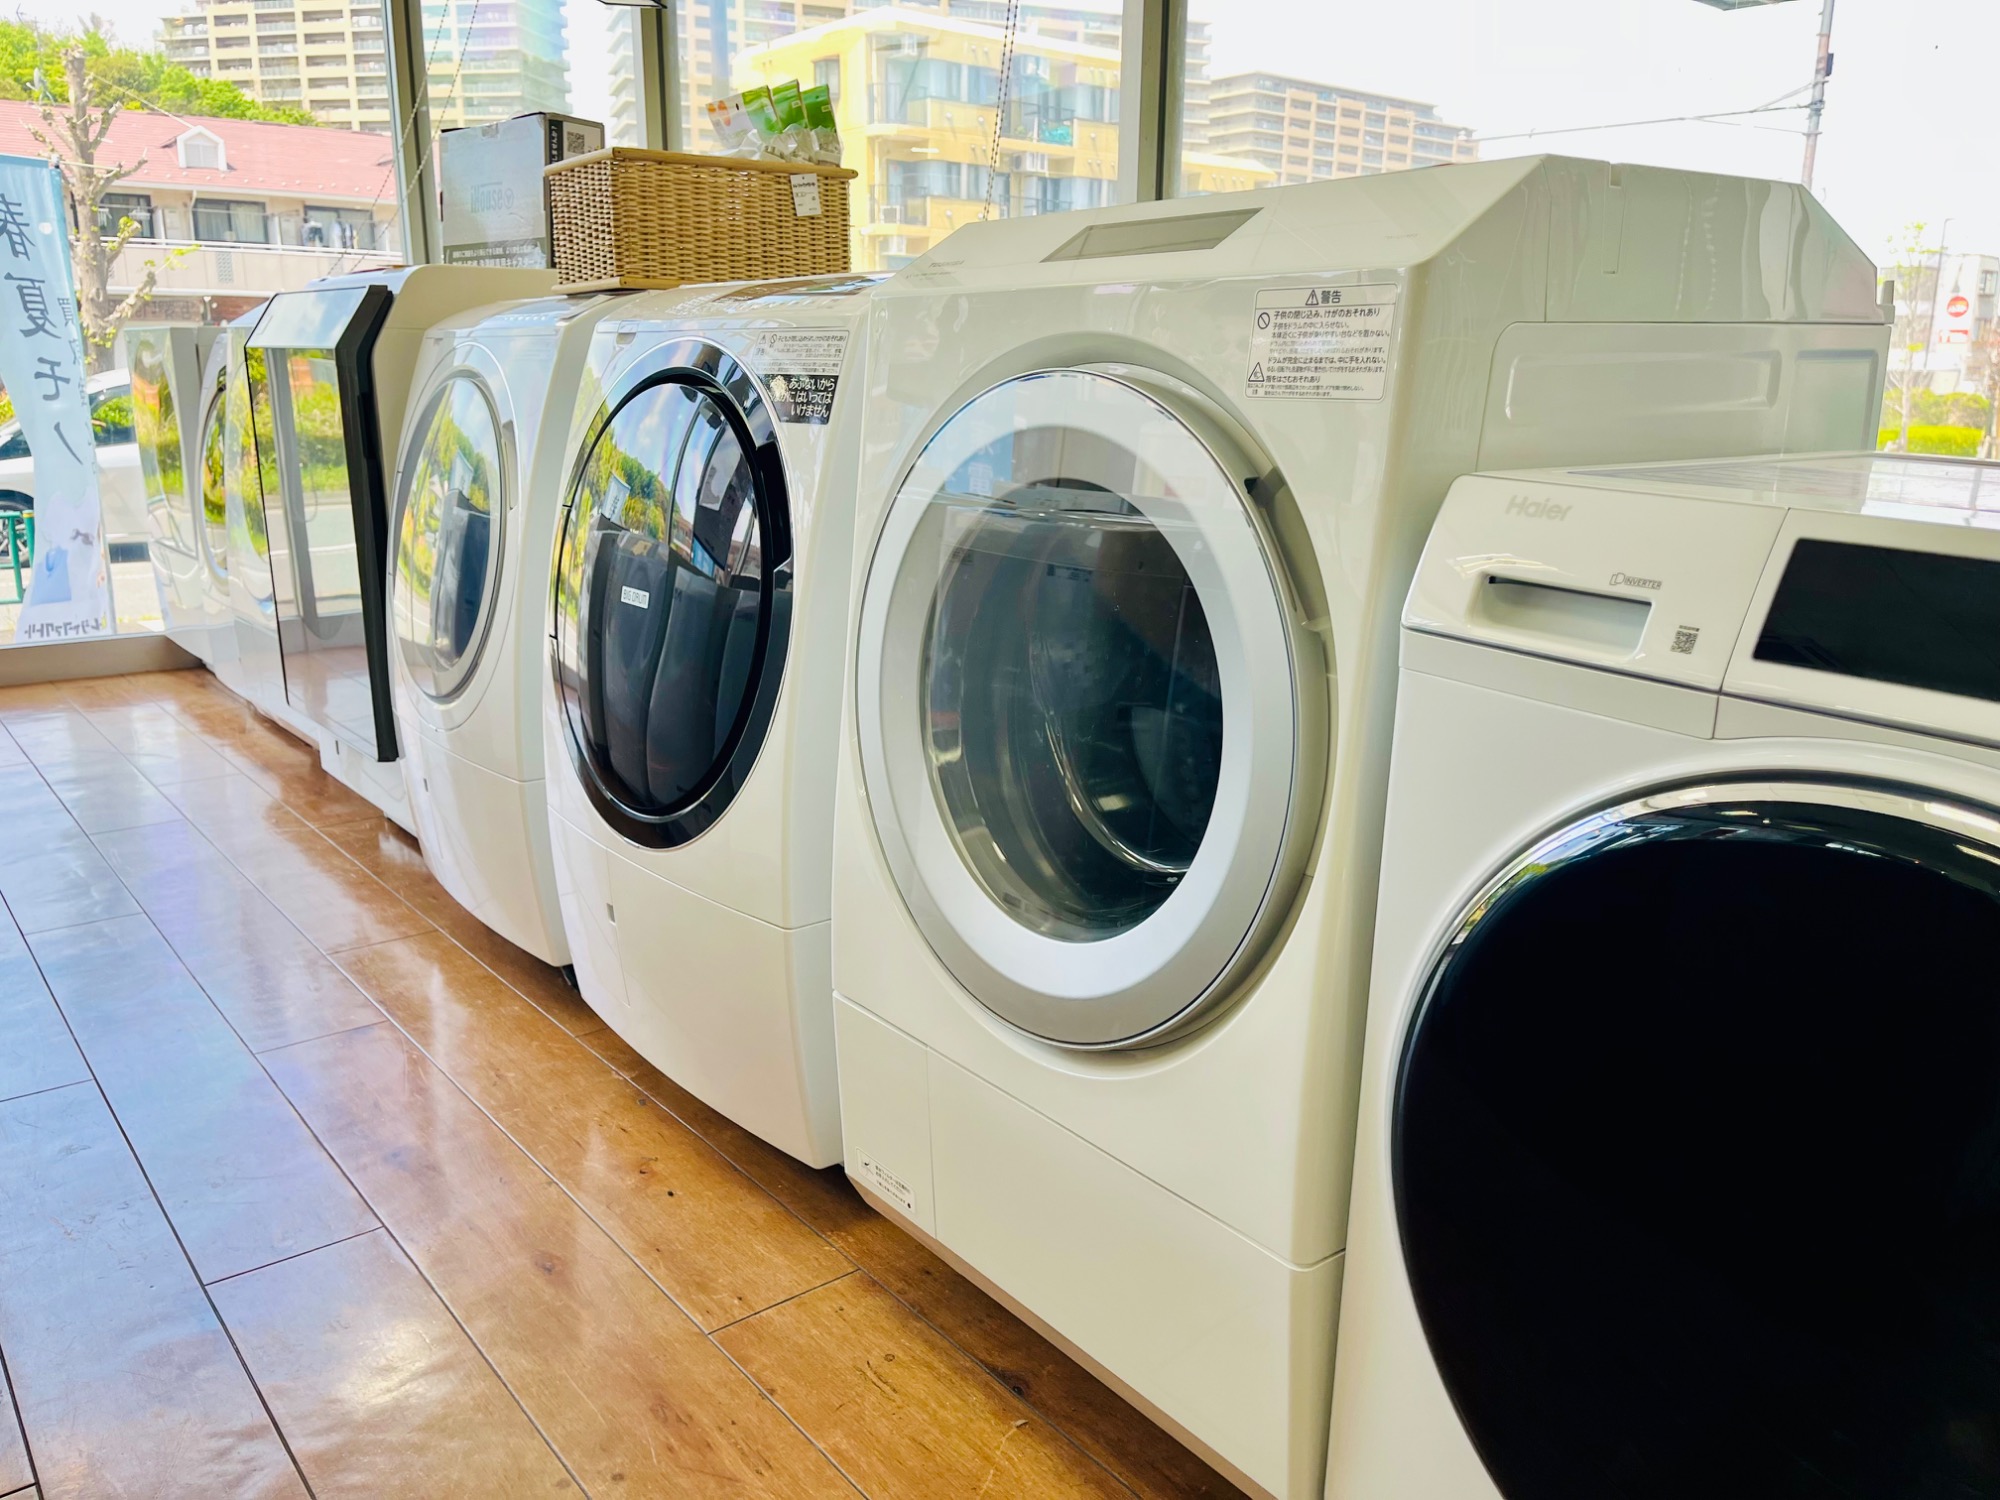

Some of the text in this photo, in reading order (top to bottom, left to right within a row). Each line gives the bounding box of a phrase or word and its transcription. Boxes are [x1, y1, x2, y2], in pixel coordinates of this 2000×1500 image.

[1320, 290, 1342, 304] 警告
[789, 378, 835, 390] あぶないから
[791, 405, 829, 418] いけません
[1505, 495, 1573, 521] Haier
[1625, 576, 1662, 590] INVERTER
